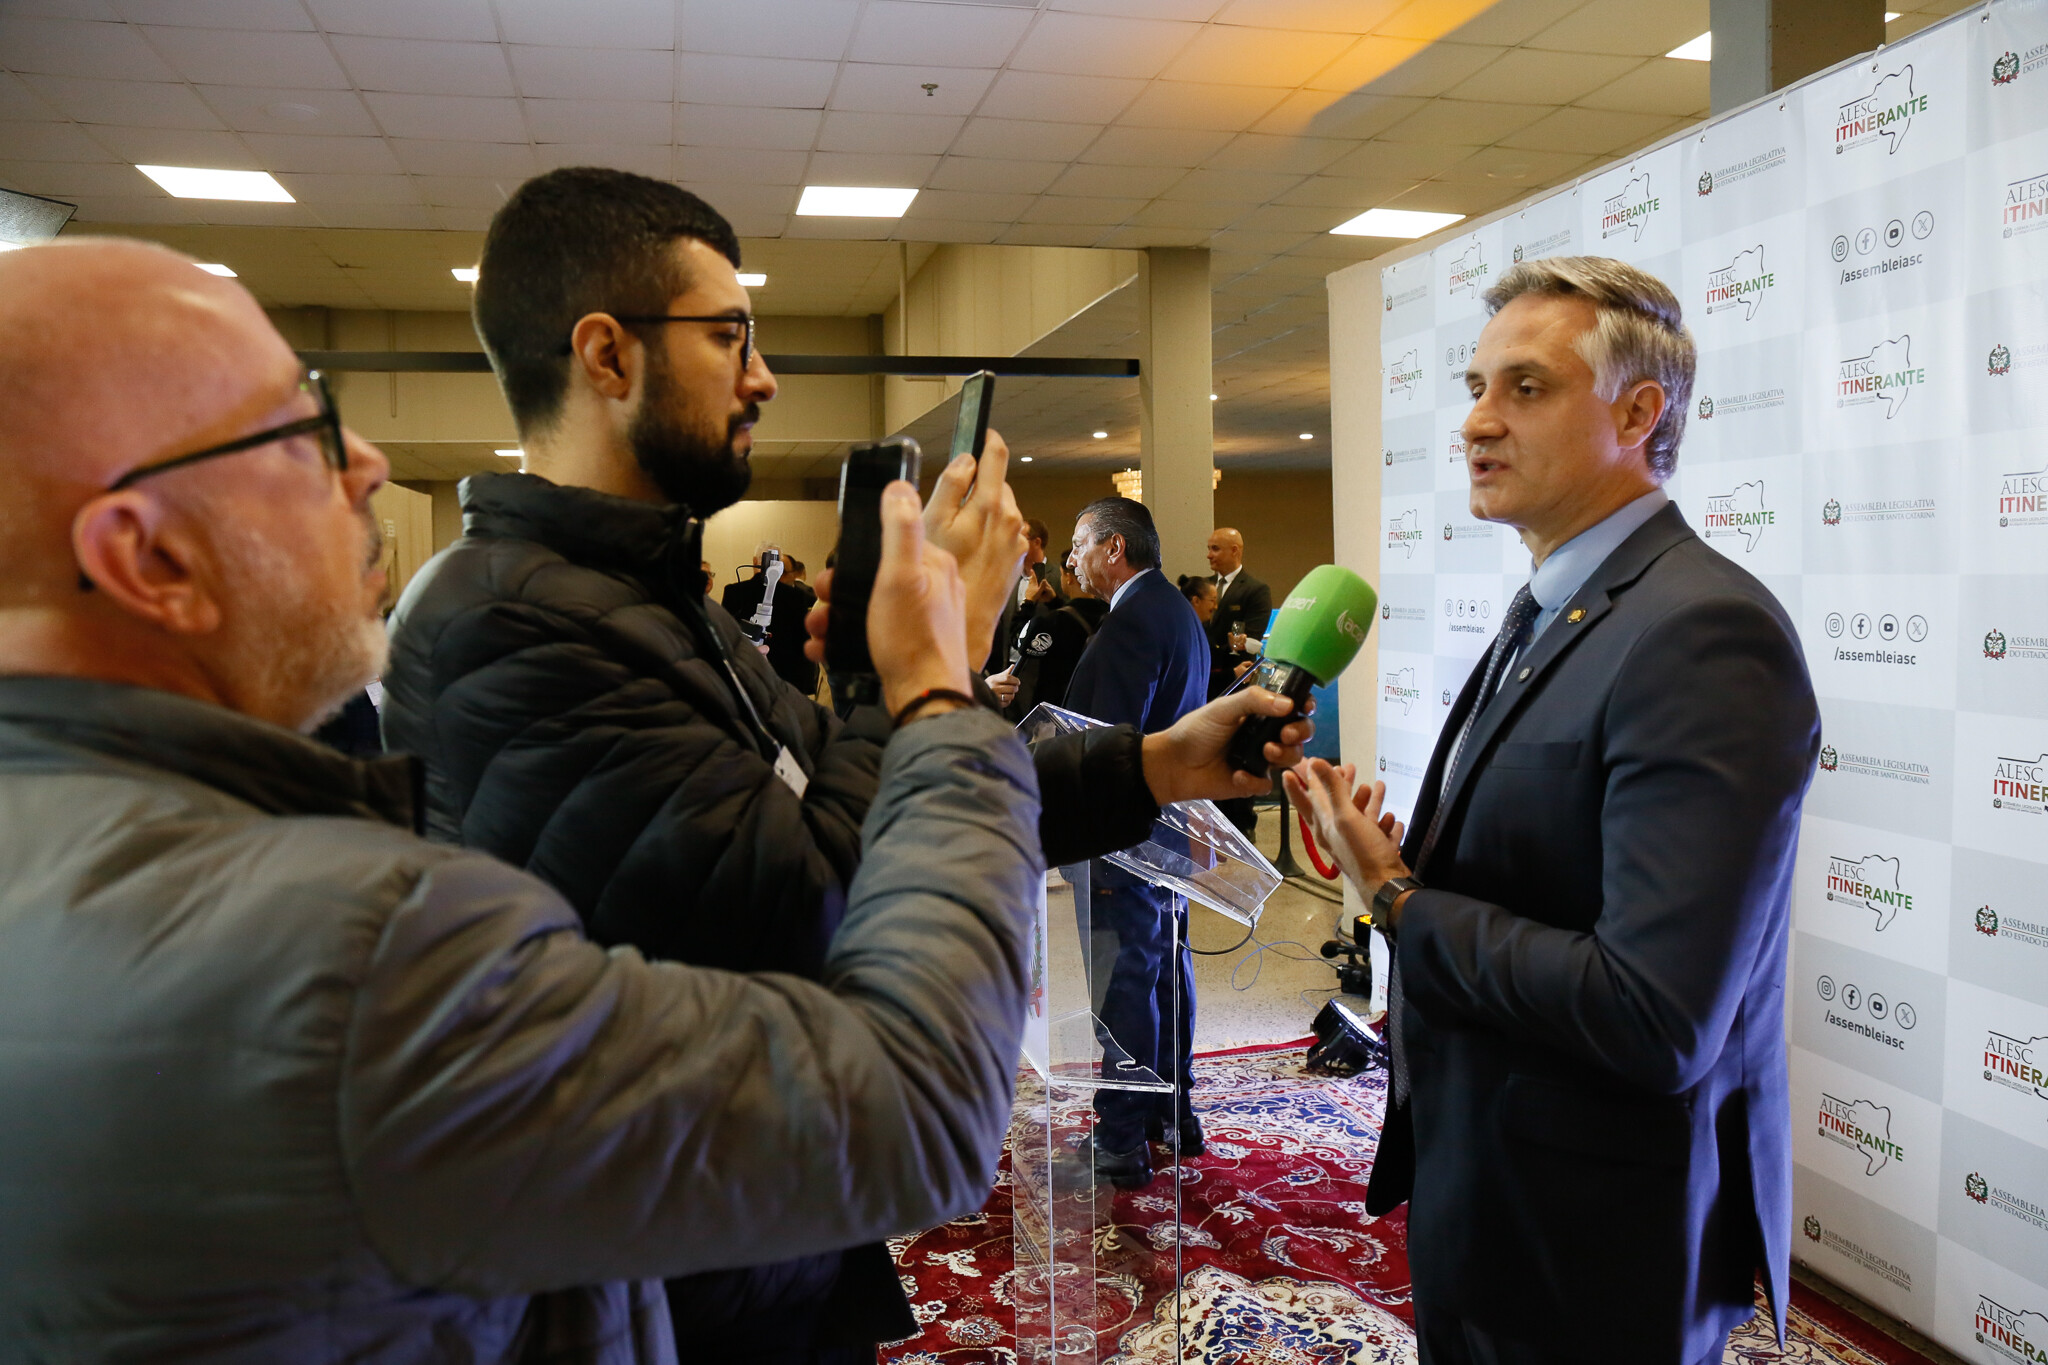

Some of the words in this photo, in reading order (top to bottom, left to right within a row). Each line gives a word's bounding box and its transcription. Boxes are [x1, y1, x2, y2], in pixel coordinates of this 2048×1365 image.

[1836, 95, 1927, 142] ITINERANTE
[1837, 98, 1878, 125] ALESC
[1714, 161, 1747, 178] ASSEMBLEIA
[1749, 147, 1785, 166] LEGISLATIVA
[1603, 197, 1627, 215] ALESC
[2005, 180, 2048, 206] ALES
[1603, 198, 1659, 229] ITINERANTE
[1450, 264, 1488, 287] ITINERANTE
[1708, 270, 1736, 289] ALESC
[1840, 254, 1923, 284] /assembleiasc
[1707, 273, 1774, 303] ITINERANTE
[1390, 370, 1422, 386] ITINERANTE
[1838, 360, 1875, 380] ALESC
[1838, 368, 1924, 396] ITINERANTE
[1706, 499, 1736, 512] ALESC
[1845, 502, 1886, 512] ASSEMBLEIA
[1889, 499, 1934, 510] LEGISLATIVA
[1706, 511, 1774, 527] ITINERANTE
[1388, 530, 1422, 541] ITINERANTE
[1834, 646, 1916, 665] /assembleiasc
[1384, 686, 1420, 699] ITINERANTE
[1840, 753, 1880, 766] ASSEMBLEIA
[1883, 759, 1930, 774] LEGISLATIVA
[1994, 762, 2043, 783] ALESC
[1828, 862, 1865, 881] ALESC
[1828, 875, 1912, 910] ITINERANTE
[2002, 930, 2012, 938] DO
[2014, 933, 2041, 946] ESTADO
[1824, 1010, 1904, 1050] /assembleiasc
[1986, 1037, 2033, 1064] ALESC
[1820, 1098, 1856, 1124] ALESC
[1819, 1110, 1904, 1162] ITINERANTE
[1990, 1198, 2002, 1209] DO
[2004, 1204, 2030, 1222] ESTADO
[2032, 1218, 2042, 1228] DE
[1992, 1187, 2046, 1218] ASSEMBLEIA
[1824, 1229, 1864, 1256] ASSEMBLEIA
[1866, 1251, 1912, 1282] LEGISLATIVA
[1976, 1300, 2024, 1337] ALESC
